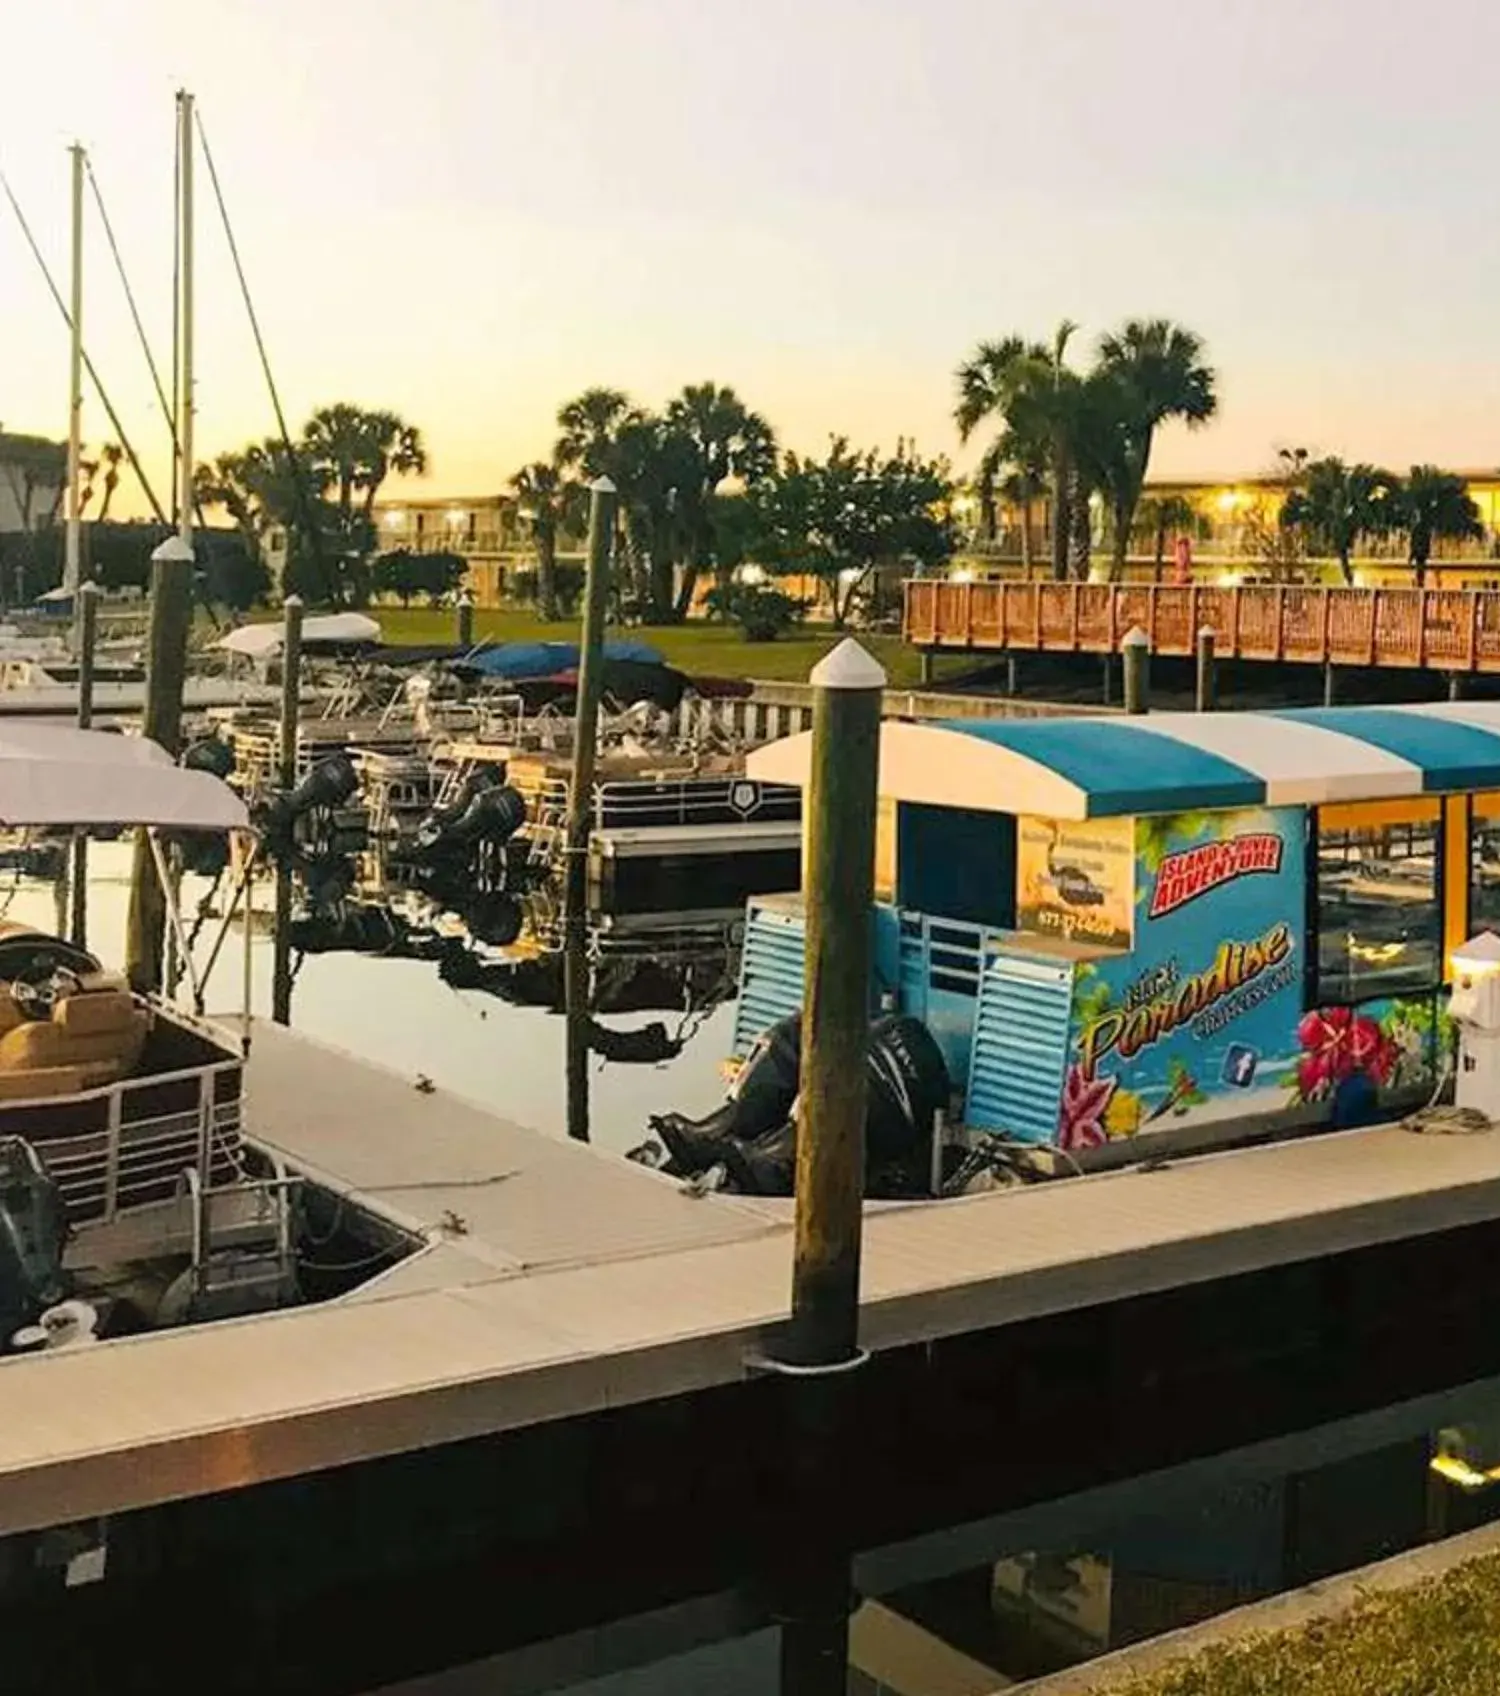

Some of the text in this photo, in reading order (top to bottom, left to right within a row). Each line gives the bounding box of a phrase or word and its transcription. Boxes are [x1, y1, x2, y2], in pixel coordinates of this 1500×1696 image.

[1153, 850, 1278, 913] ADVENTURE
[1159, 845, 1217, 881] ISLAND
[1077, 922, 1291, 1083] Paradise
